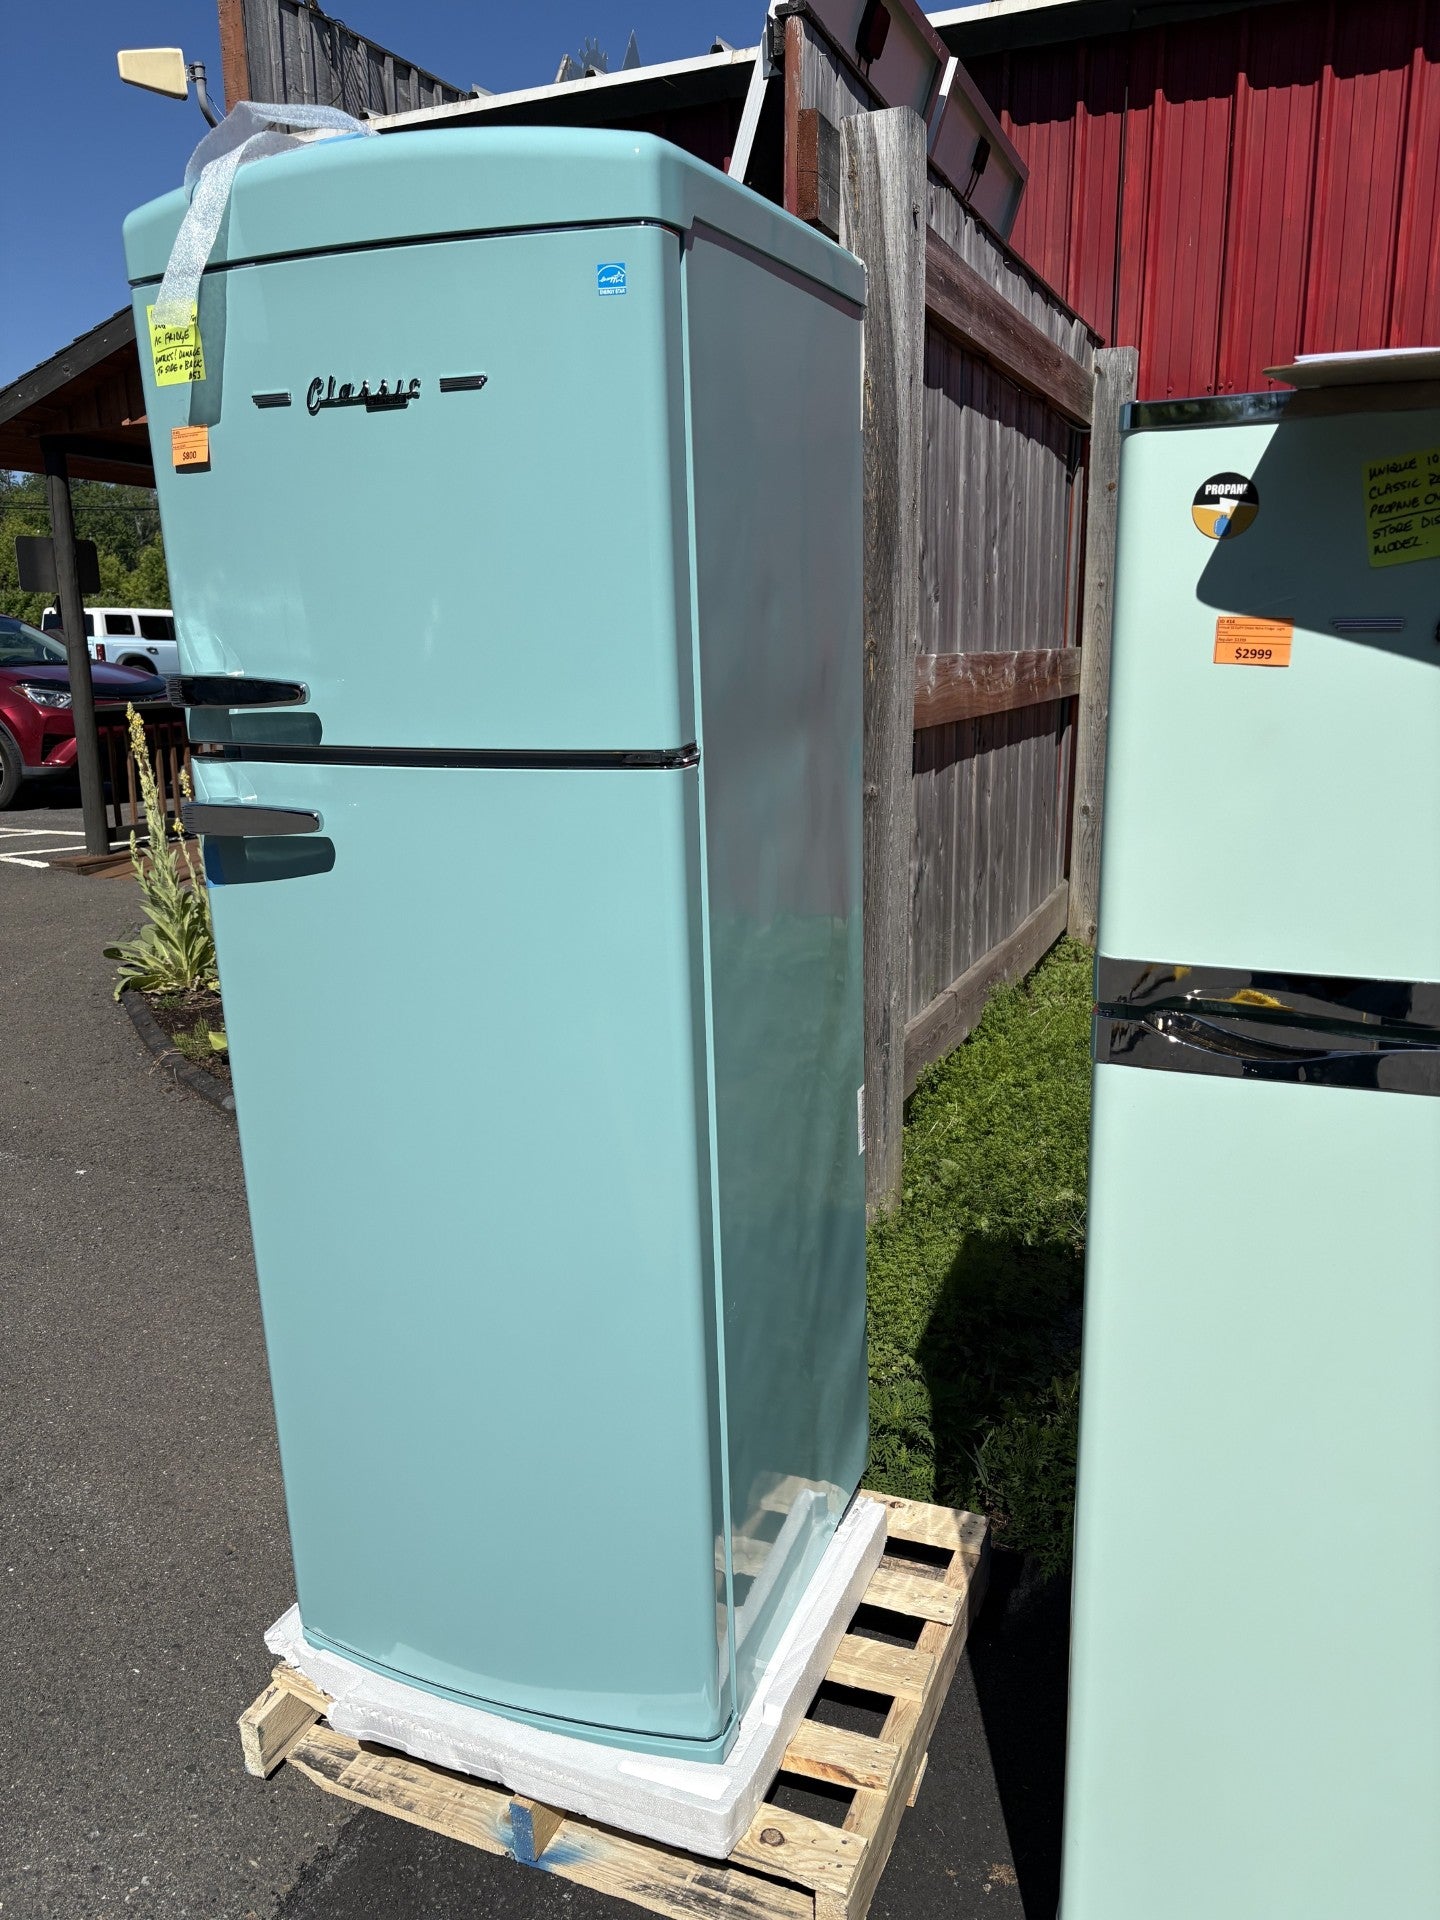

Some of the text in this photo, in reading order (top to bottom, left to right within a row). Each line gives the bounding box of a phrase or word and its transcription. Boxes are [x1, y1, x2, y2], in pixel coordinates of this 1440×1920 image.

[164, 328, 190, 345] FRIDGE
[307, 375, 421, 411] Classic
[1369, 454, 1440, 480] UNIQUE 10
[1369, 479, 1421, 499] CLASSIC
[1369, 497, 1420, 518] PROPANE
[1372, 520, 1413, 539] STORE
[1235, 647, 1272, 660] $2999
